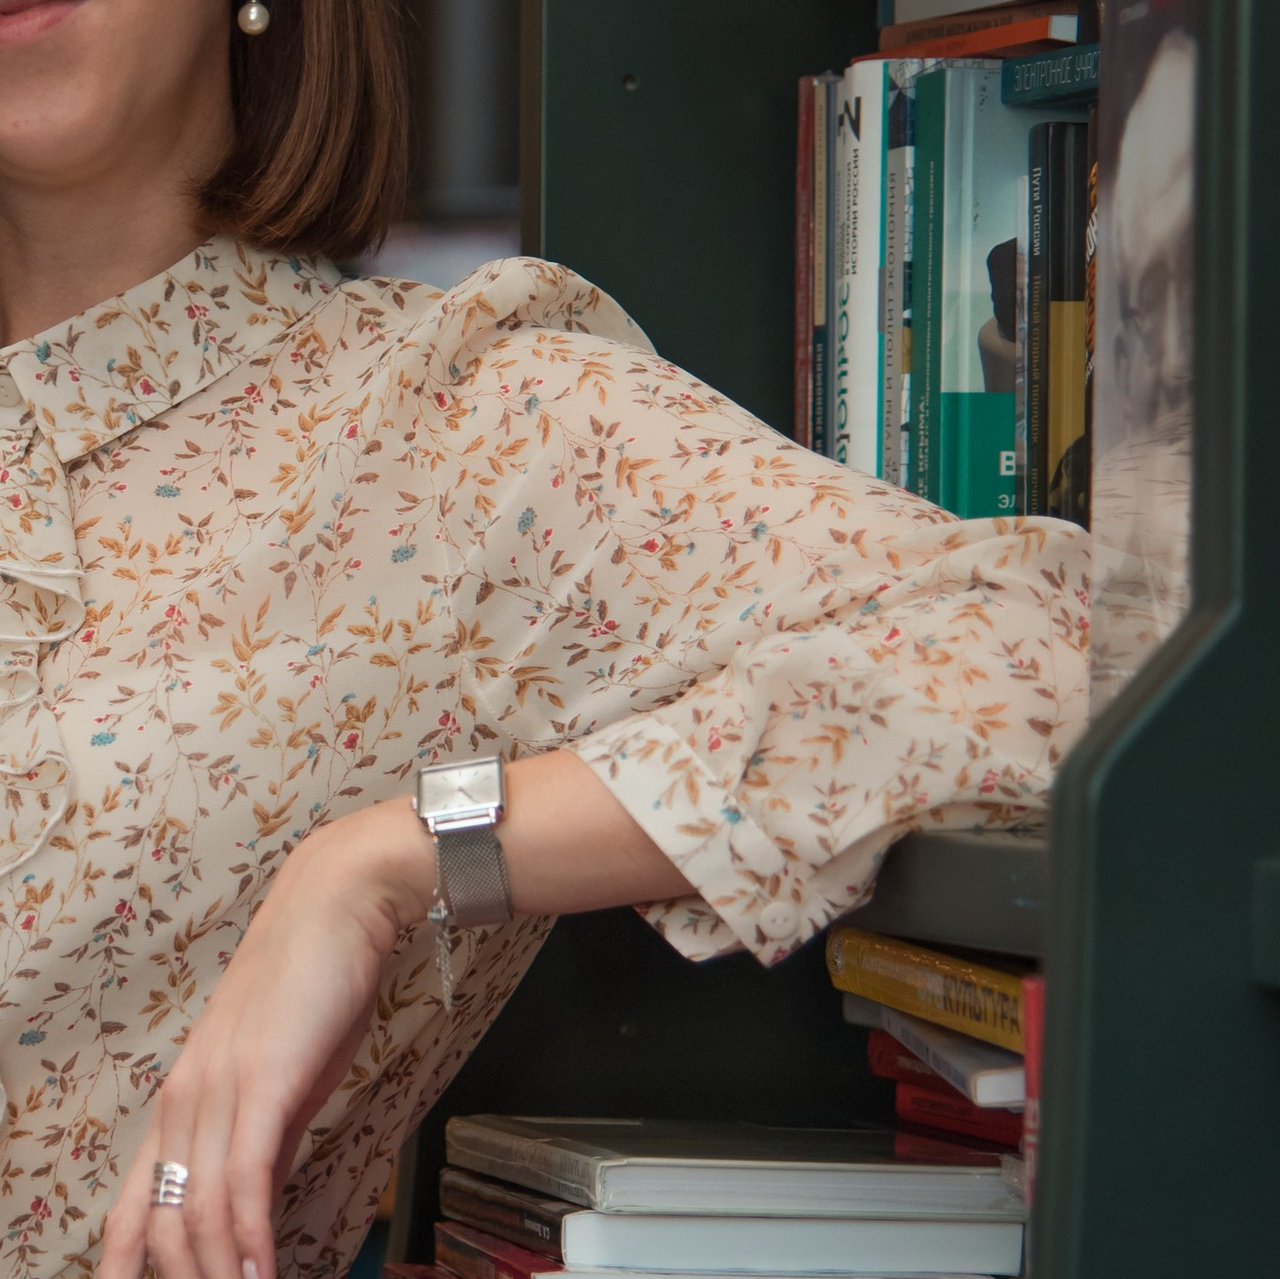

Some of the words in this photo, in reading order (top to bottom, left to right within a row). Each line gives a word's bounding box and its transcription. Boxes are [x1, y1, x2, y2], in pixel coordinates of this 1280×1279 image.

[1014, 55, 1073, 92] ЭЛЕКТРОННОЕ
[1031, 167, 1043, 201] Пути
[851, 210, 859, 275] ИСТОРИИ
[1032, 204, 1043, 256] России
[886, 172, 897, 367] ПОЛИТЭКОНОМИЯ
[885, 400, 893, 480] УКТУРЫ
